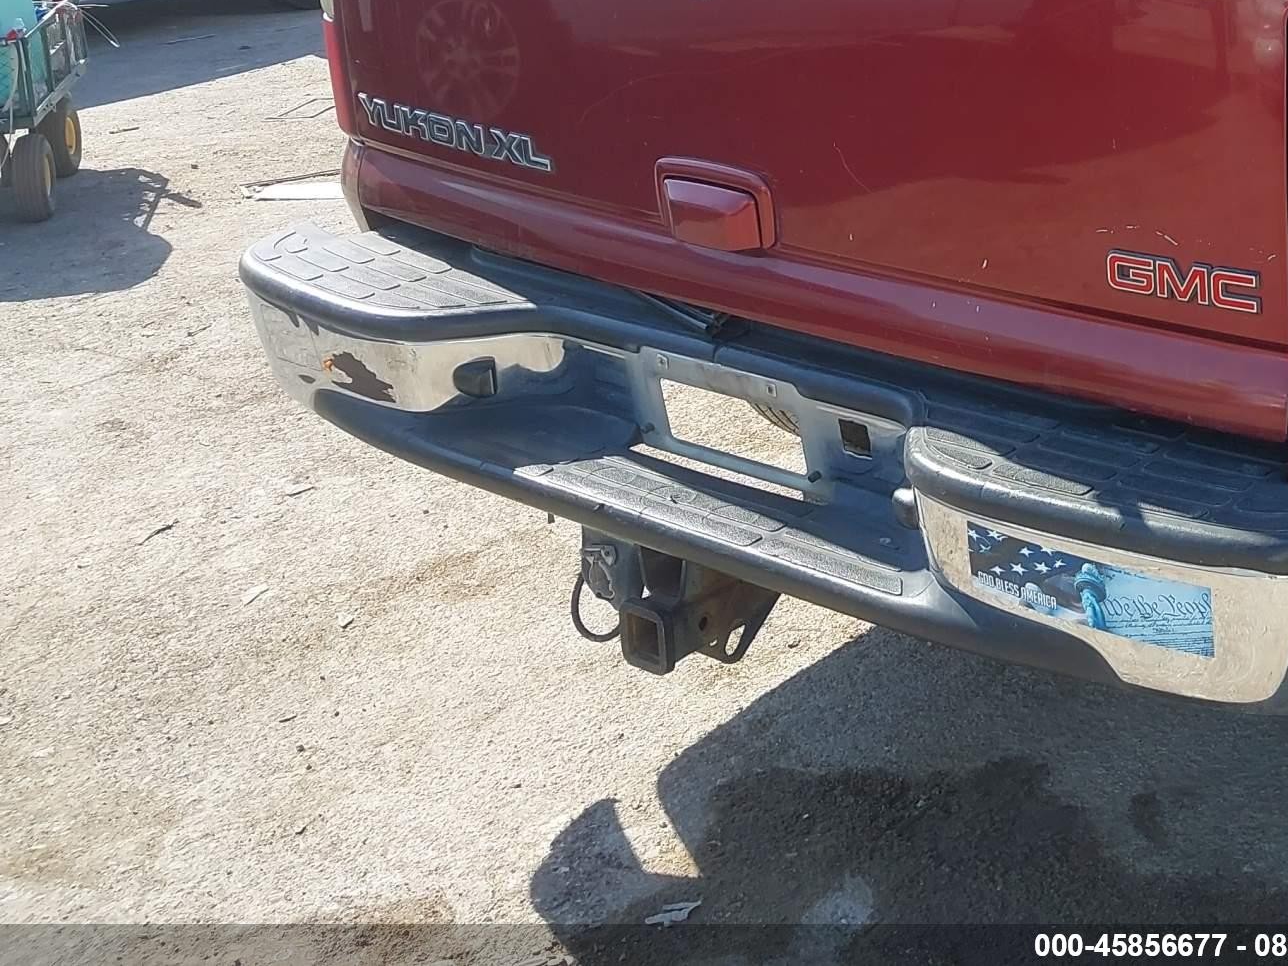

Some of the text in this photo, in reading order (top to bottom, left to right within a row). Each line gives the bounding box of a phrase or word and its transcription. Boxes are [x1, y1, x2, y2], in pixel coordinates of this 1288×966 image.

[357, 92, 553, 172] YUKON XL
[1106, 249, 1263, 314] GMC
[977, 571, 1057, 610] GOD BLESS AMERICA
[1102, 595, 1133, 618] We
